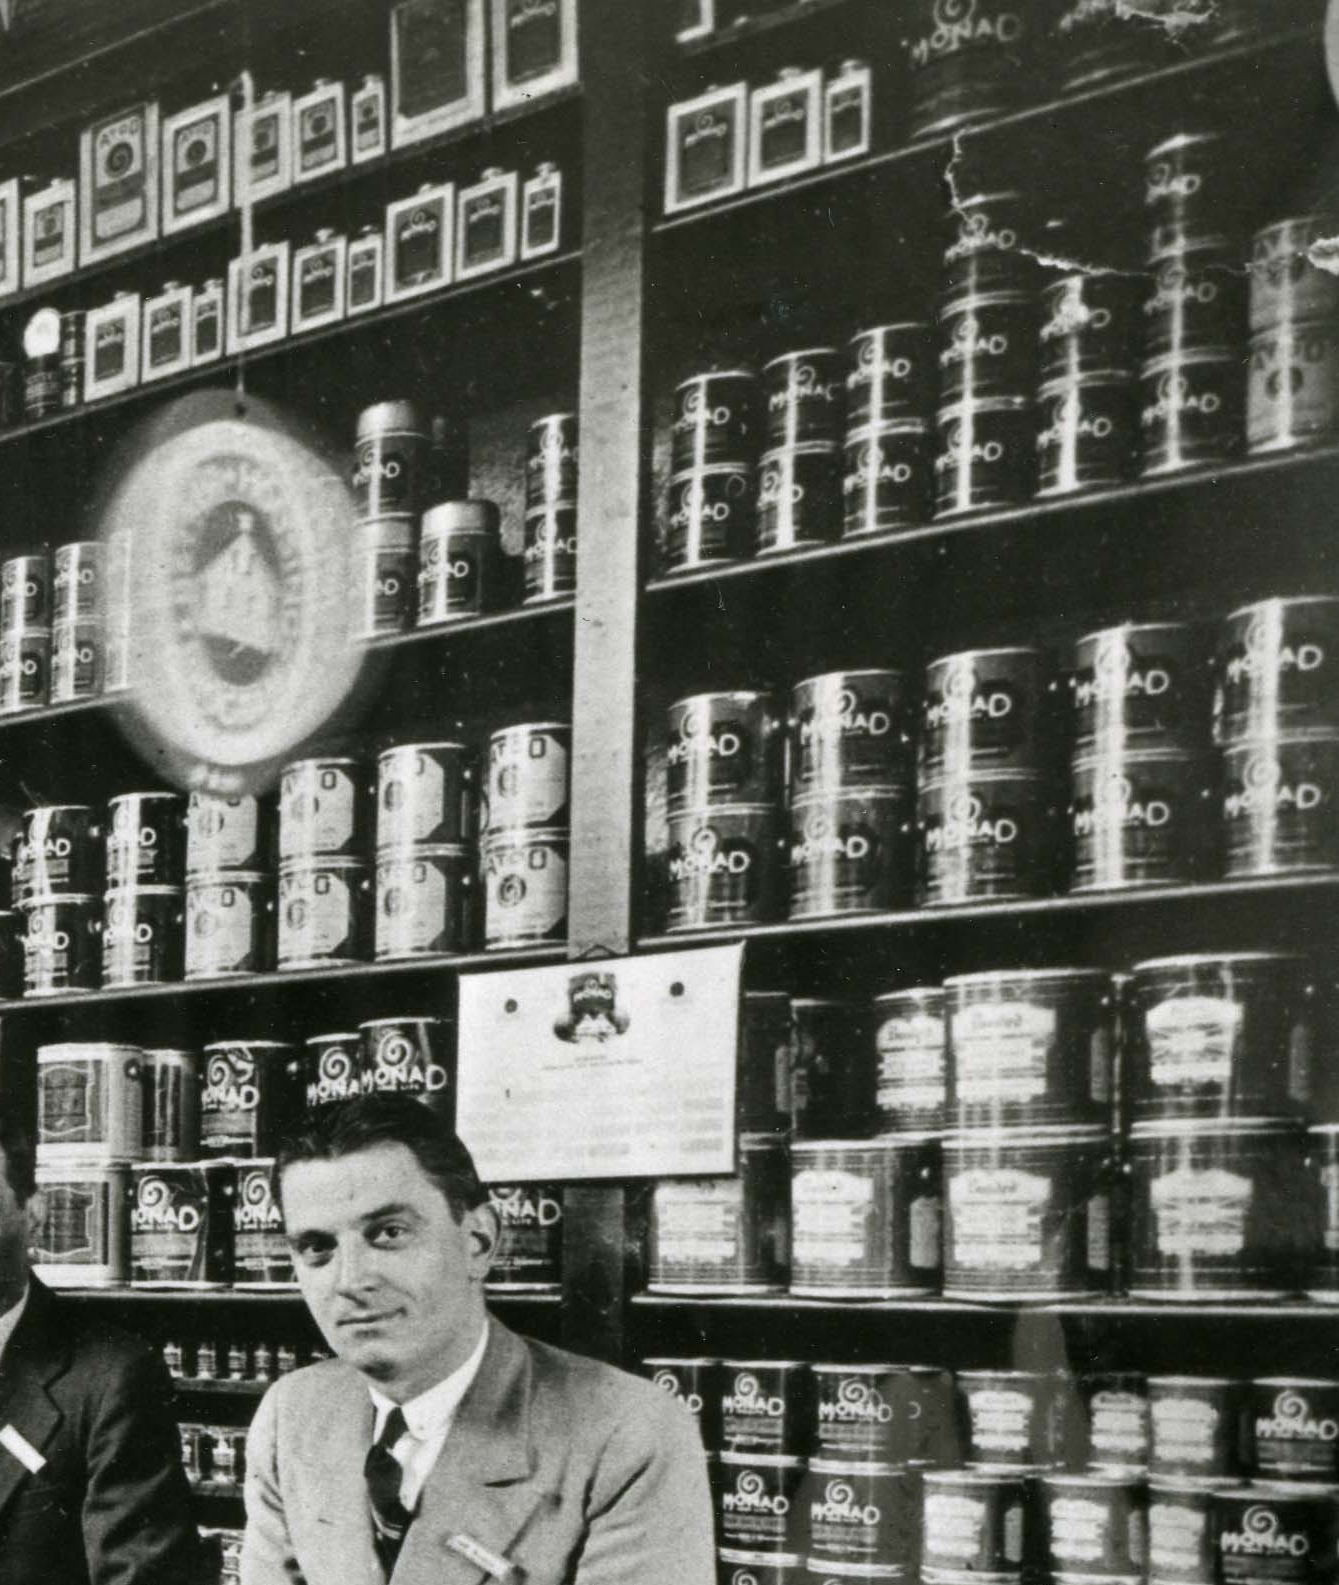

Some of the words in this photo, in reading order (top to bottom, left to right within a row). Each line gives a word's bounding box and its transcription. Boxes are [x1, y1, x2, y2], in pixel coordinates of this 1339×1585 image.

[361, 1065, 447, 1096] MONAD
[722, 1394, 785, 1416] MONAD
[819, 1402, 893, 1424] MONAD
[1256, 1416, 1338, 1441] MONAD
[722, 1492, 789, 1515] MONAD
[811, 1502, 880, 1526] MONAD
[1221, 1531, 1309, 1557] MONAD
